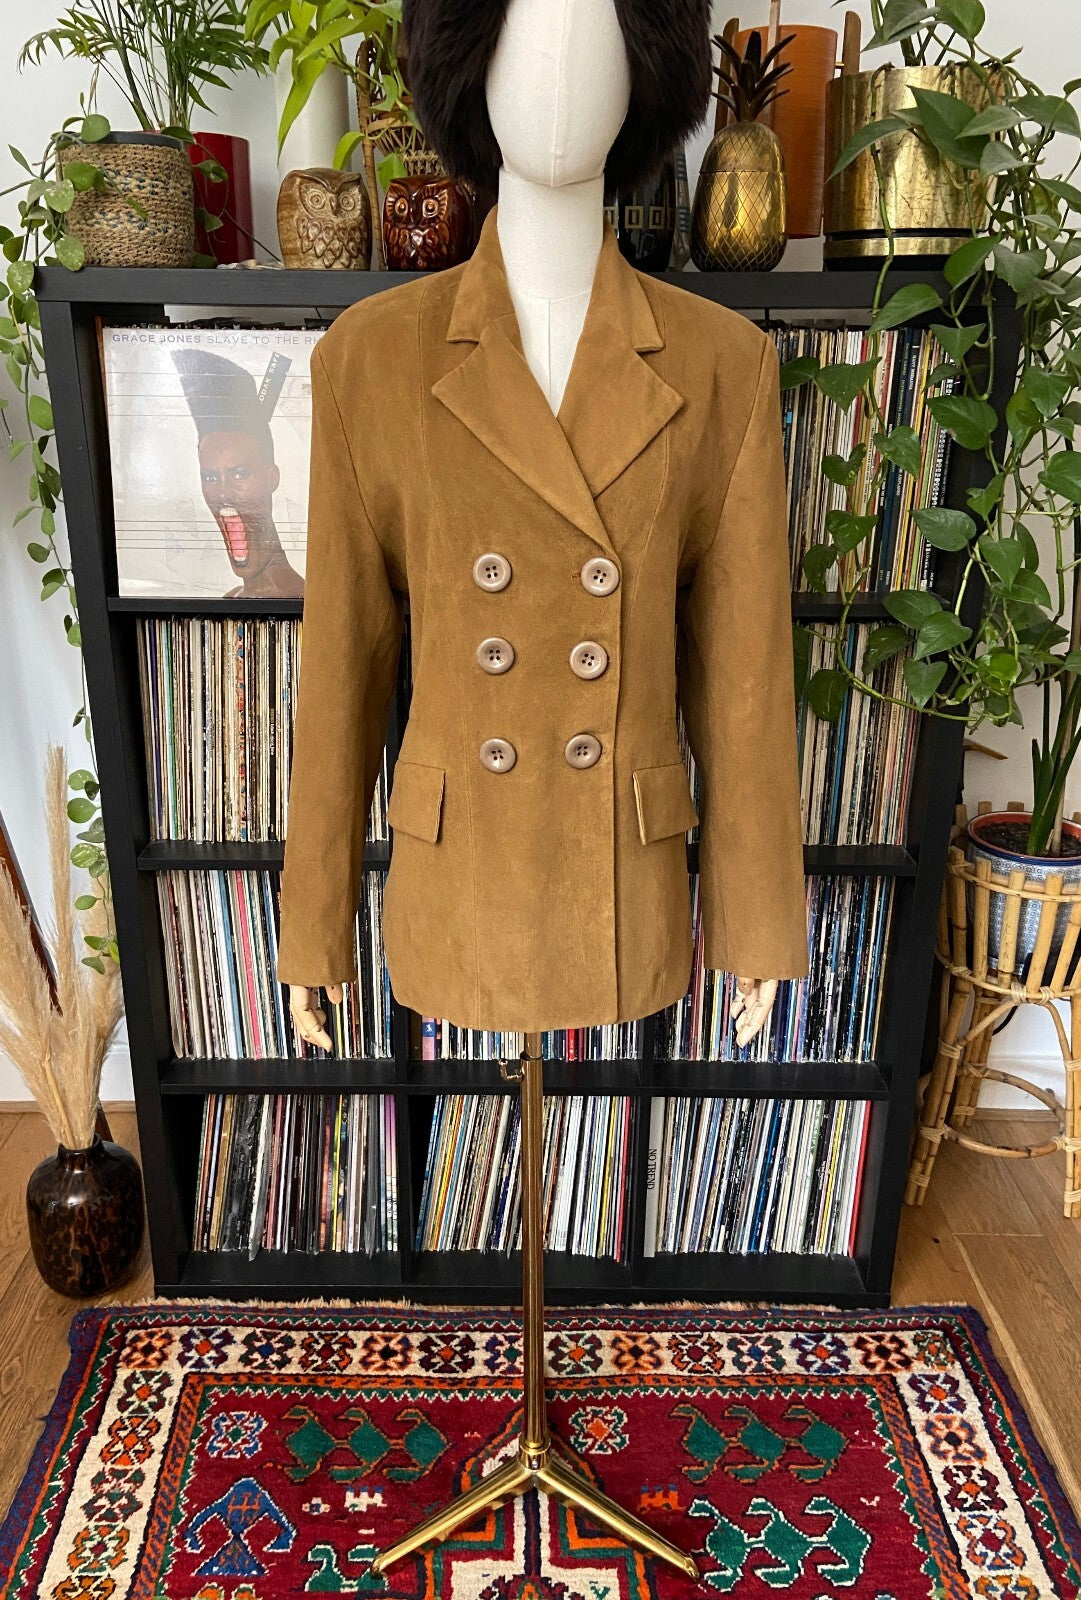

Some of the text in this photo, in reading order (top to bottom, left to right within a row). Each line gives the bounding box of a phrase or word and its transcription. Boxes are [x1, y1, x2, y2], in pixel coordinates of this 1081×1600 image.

[112, 334, 156, 343] GRACE
[160, 334, 202, 344] JONES
[206, 335, 249, 345] SLAVE
[253, 336, 271, 345] TO
[274, 336, 300, 345] THE
[647, 1149, 657, 1190] NO TREND
